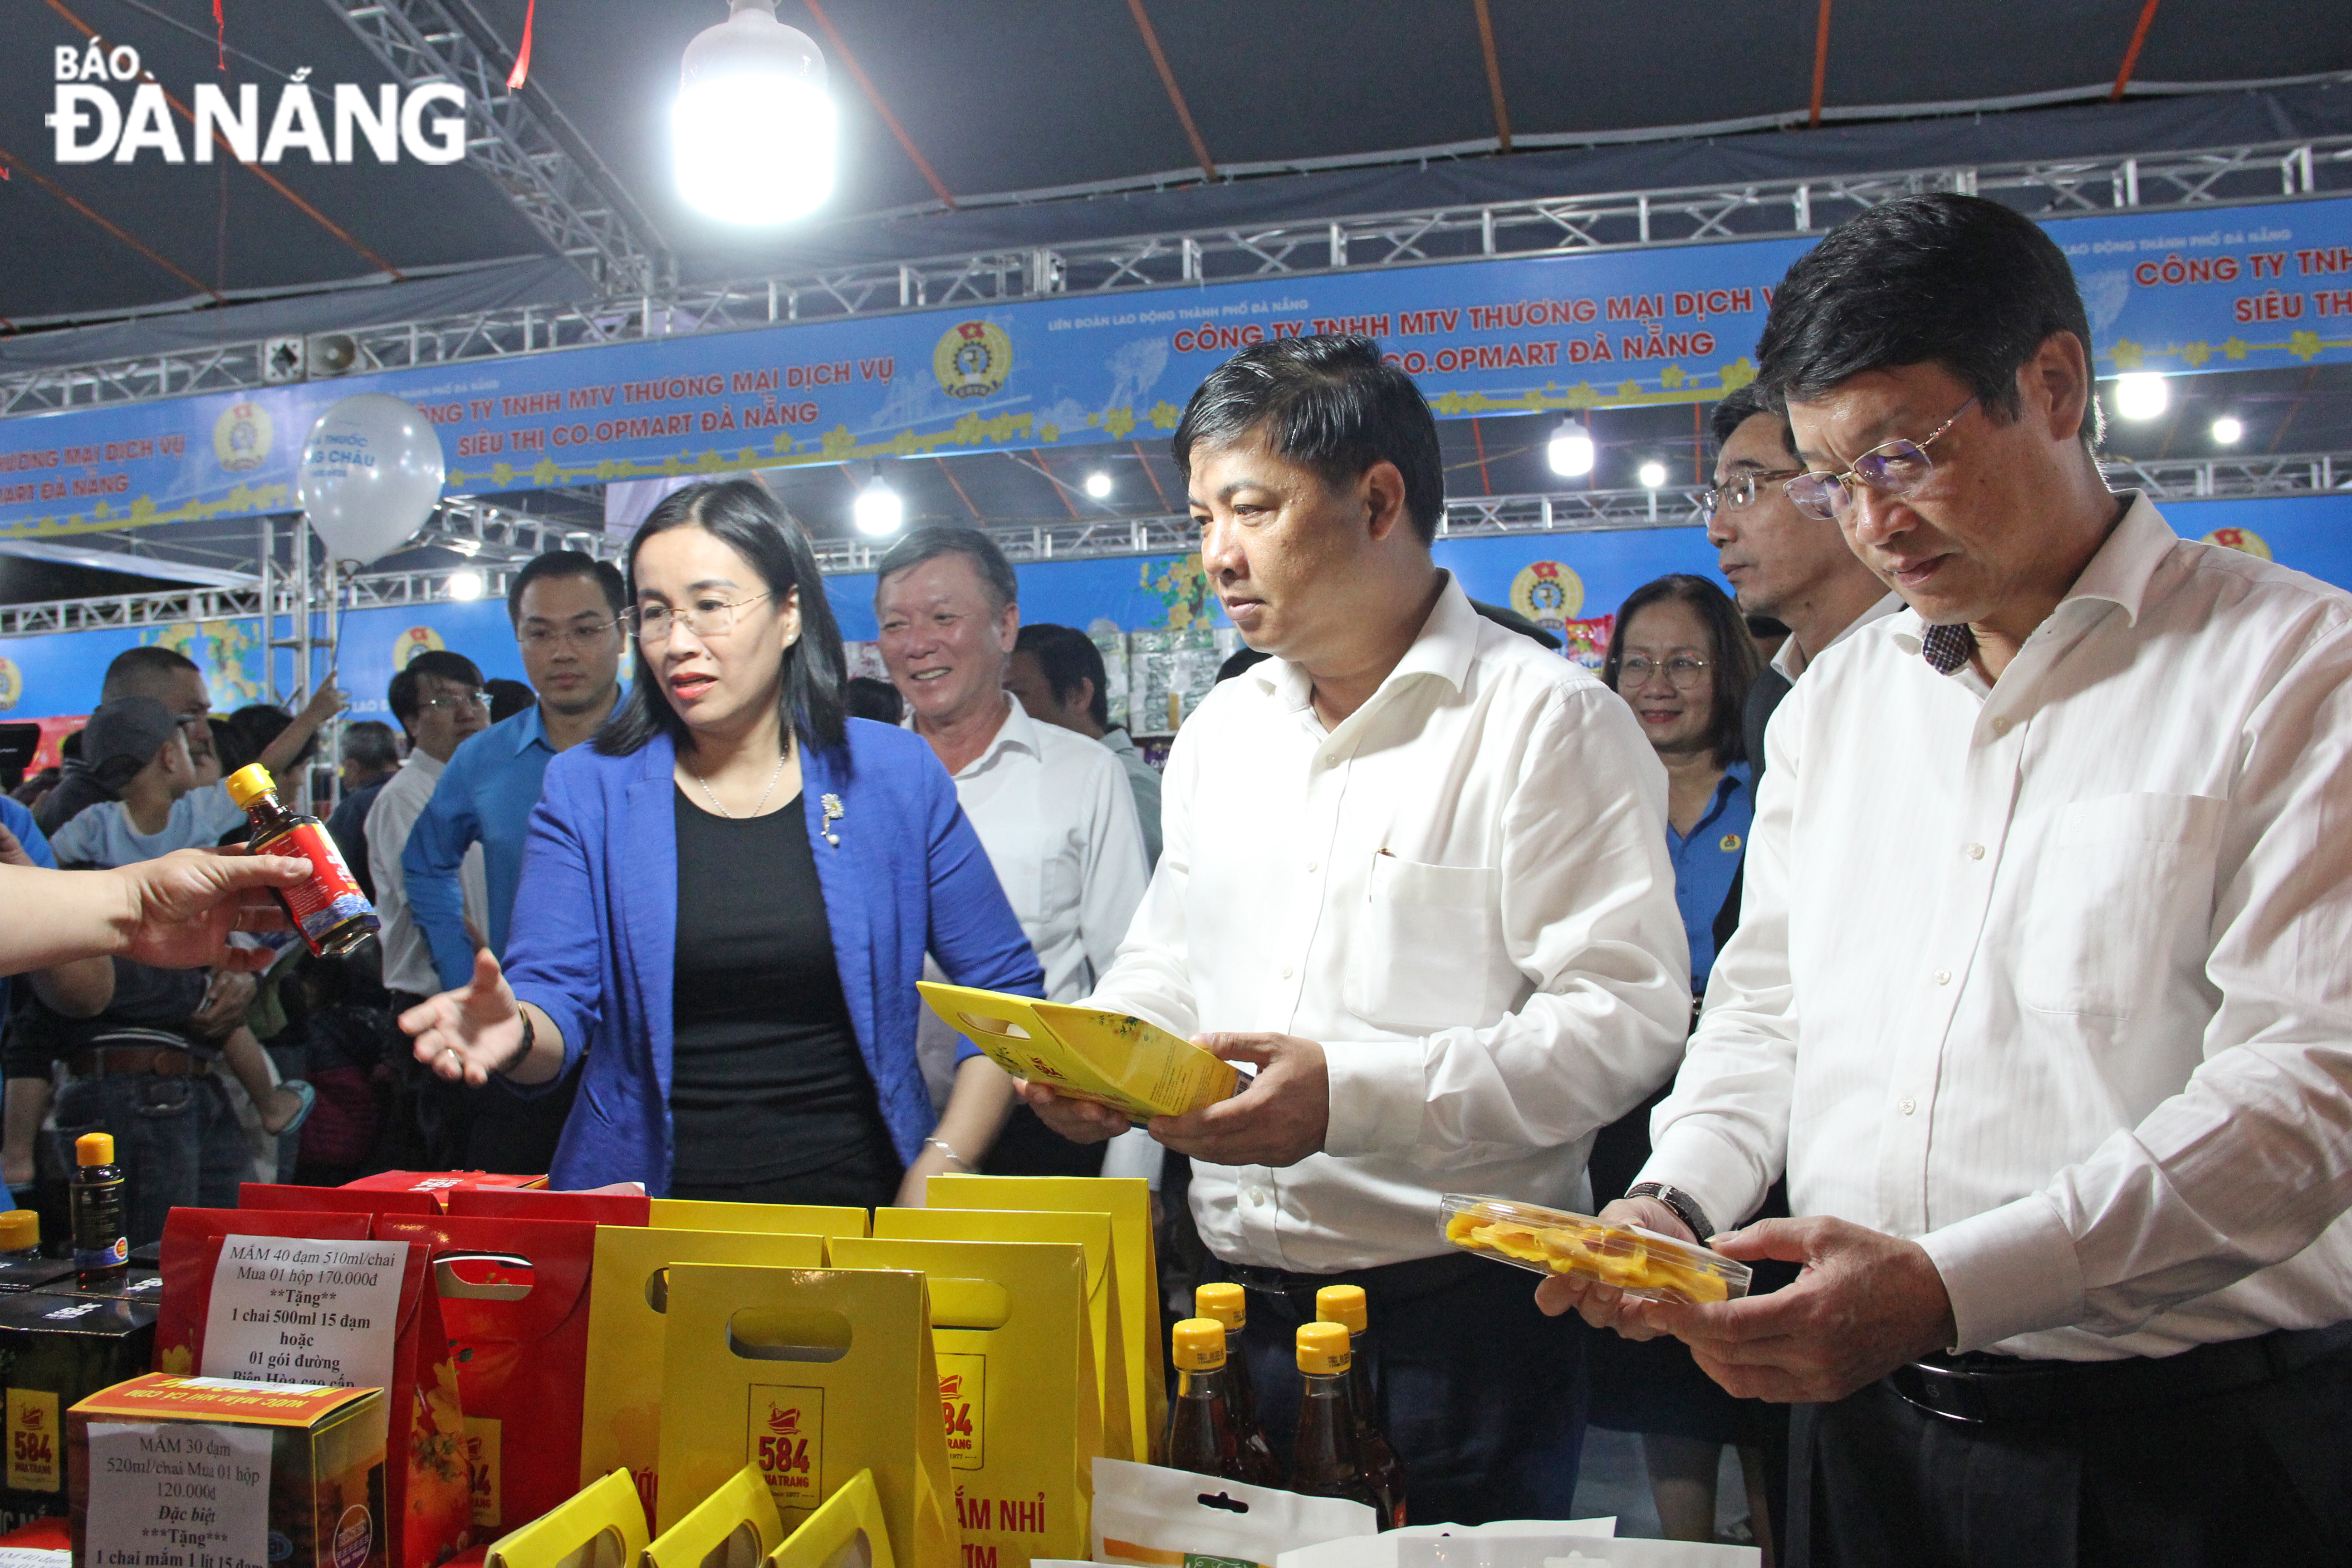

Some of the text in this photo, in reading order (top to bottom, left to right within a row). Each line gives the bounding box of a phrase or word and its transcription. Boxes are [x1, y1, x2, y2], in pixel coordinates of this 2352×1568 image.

[2136, 253, 2239, 286] CÔNG
[2249, 253, 2285, 278] TY
[1049, 320, 1072, 331] LIÊN
[1075, 316, 1109, 329] ĐOÀN
[1113, 314, 1135, 325] LAO
[1140, 310, 1176, 323] ĐỘNG
[1178, 306, 1219, 319] THÀNH
[1222, 300, 1249, 316] PHỐ
[1251, 300, 1269, 313] ĐÀ
[2235, 291, 2303, 323] SIÊU
[1174, 323, 1263, 352] CÔNG
[1401, 310, 1459, 335] MTV
[1469, 299, 1597, 330] THƯƠNG
[1607, 294, 1665, 326] MẠI
[1675, 288, 1753, 321] DỊCH
[1568, 332, 1612, 363] ĐÀ
[1623, 323, 1715, 359] NẴNG
[470, 399, 494, 420] TY
[501, 392, 561, 416] TNHH
[569, 386, 614, 409] MTV
[624, 375, 725, 405] THƯƠNG
[732, 368, 779, 397] MẠI
[787, 362, 851, 393] DỊCH
[859, 358, 894, 384] VỤ
[459, 395, 818, 456] SIÊU THỊ CO.OPMART ĐÀ NẴNG
[105, 439, 153, 466] DỊCH
[158, 435, 186, 459] VỤ
[229, 1245, 396, 1267] MẮM 40 đạm 510ml/chai
[237, 1266, 378, 1286] Mua 01 hộp 170.000đ
[232, 1308, 370, 1331] 1 chai 500ml 15 đạm
[280, 1332, 314, 1349] hoặc
[250, 1351, 340, 1373] 01 gói đường
[123, 1389, 164, 1398] CƠM
[159, 1392, 189, 1400] CÁ
[218, 1395, 263, 1406] MẮM
[261, 1397, 309, 1408] NƯỚC
[14, 1431, 52, 1463] 584
[139, 1434, 181, 1453] MẮM
[186, 1439, 203, 1454] 30
[759, 1436, 810, 1473] 584
[107, 1457, 260, 1486] 520ml/chai Mua 01 hộp
[158, 1481, 216, 1500] 120.000đ
[158, 1505, 216, 1526] Đặc biệt
[1000, 1491, 1045, 1534] NHỈ
[97, 1549, 102, 1564] 1
[109, 1550, 140, 1565] chai
[145, 1547, 183, 1567] mắm
[190, 1553, 194, 1568] 1
[219, 1556, 232, 1568] 15
